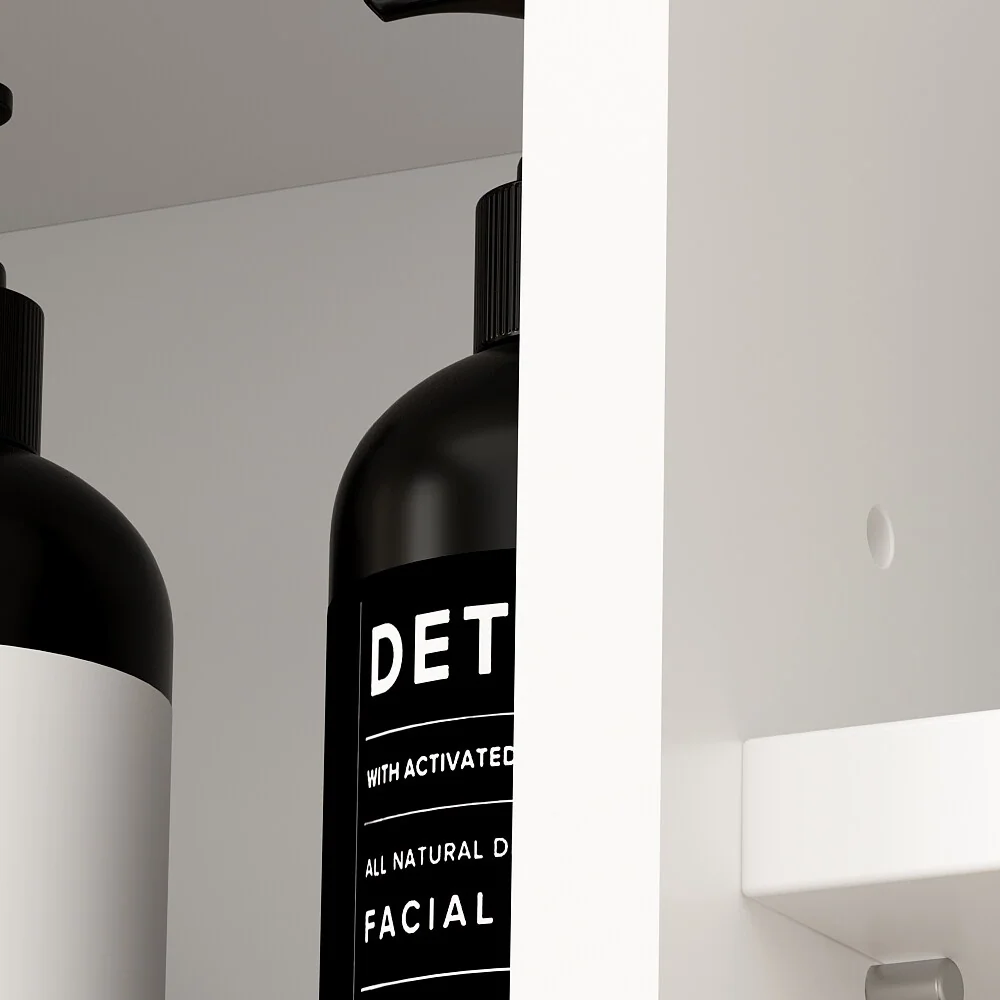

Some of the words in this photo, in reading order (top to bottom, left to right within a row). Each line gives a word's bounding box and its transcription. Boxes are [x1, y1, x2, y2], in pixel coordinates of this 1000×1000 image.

[371, 603, 508, 696] DET
[367, 762, 399, 788] WITH
[404, 746, 513, 779] ACTIVATED
[366, 856, 386, 877] ALL
[394, 840, 483, 870] NATURAL
[494, 838, 508, 857] D
[365, 892, 493, 943] FACIAL
